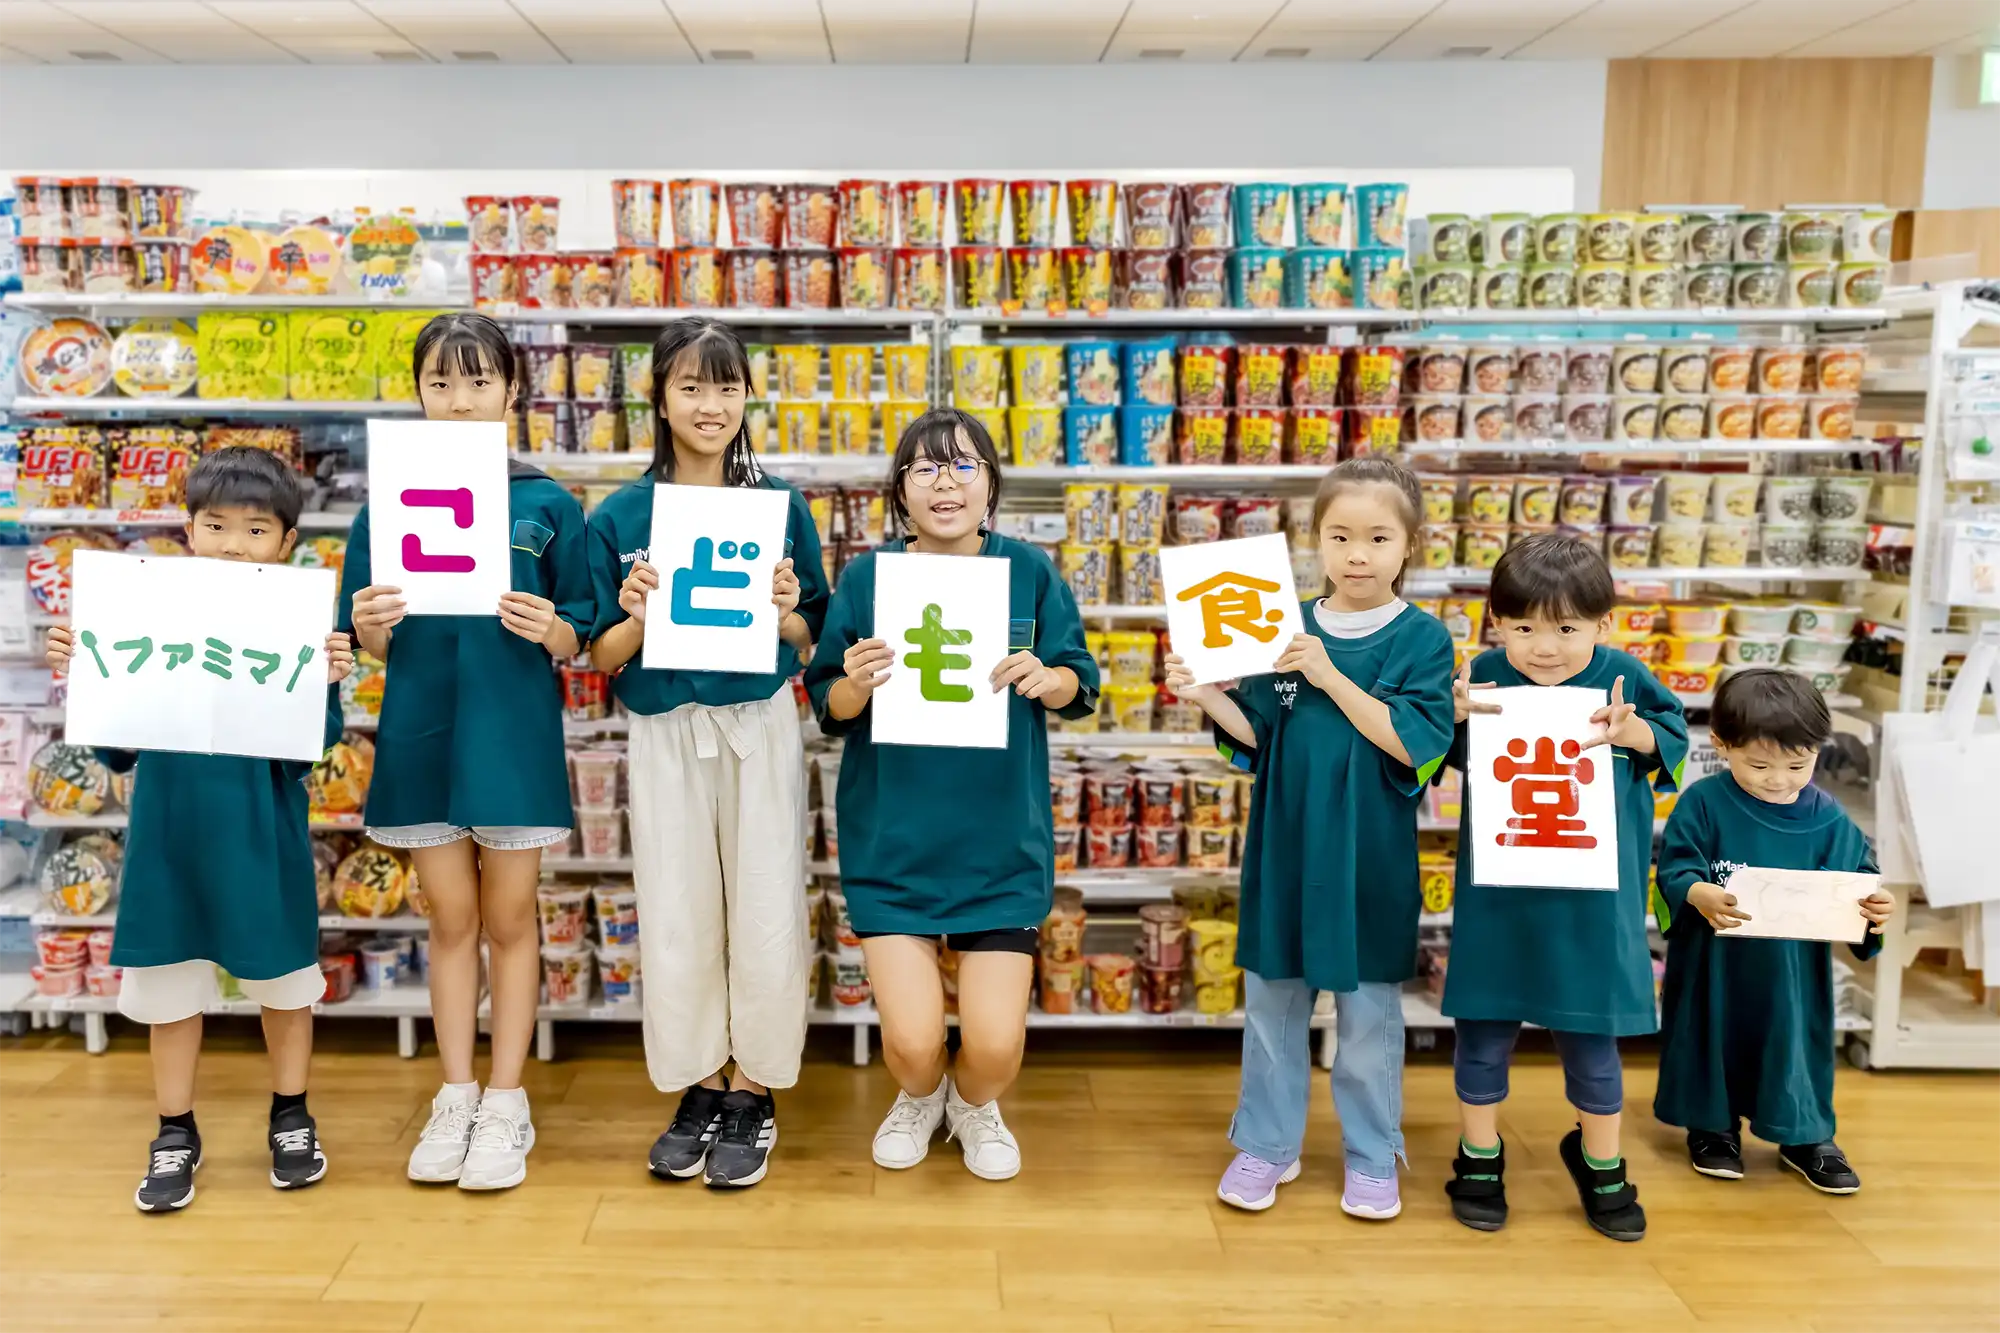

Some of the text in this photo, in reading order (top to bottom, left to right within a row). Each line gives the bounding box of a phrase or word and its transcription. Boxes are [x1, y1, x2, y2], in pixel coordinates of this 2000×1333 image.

[400, 488, 476, 573] こ
[670, 536, 760, 628] ど
[1176, 571, 1285, 649] 食
[113, 636, 281, 684] ファミマ
[904, 603, 973, 702] も
[1494, 737, 1598, 850] 堂
